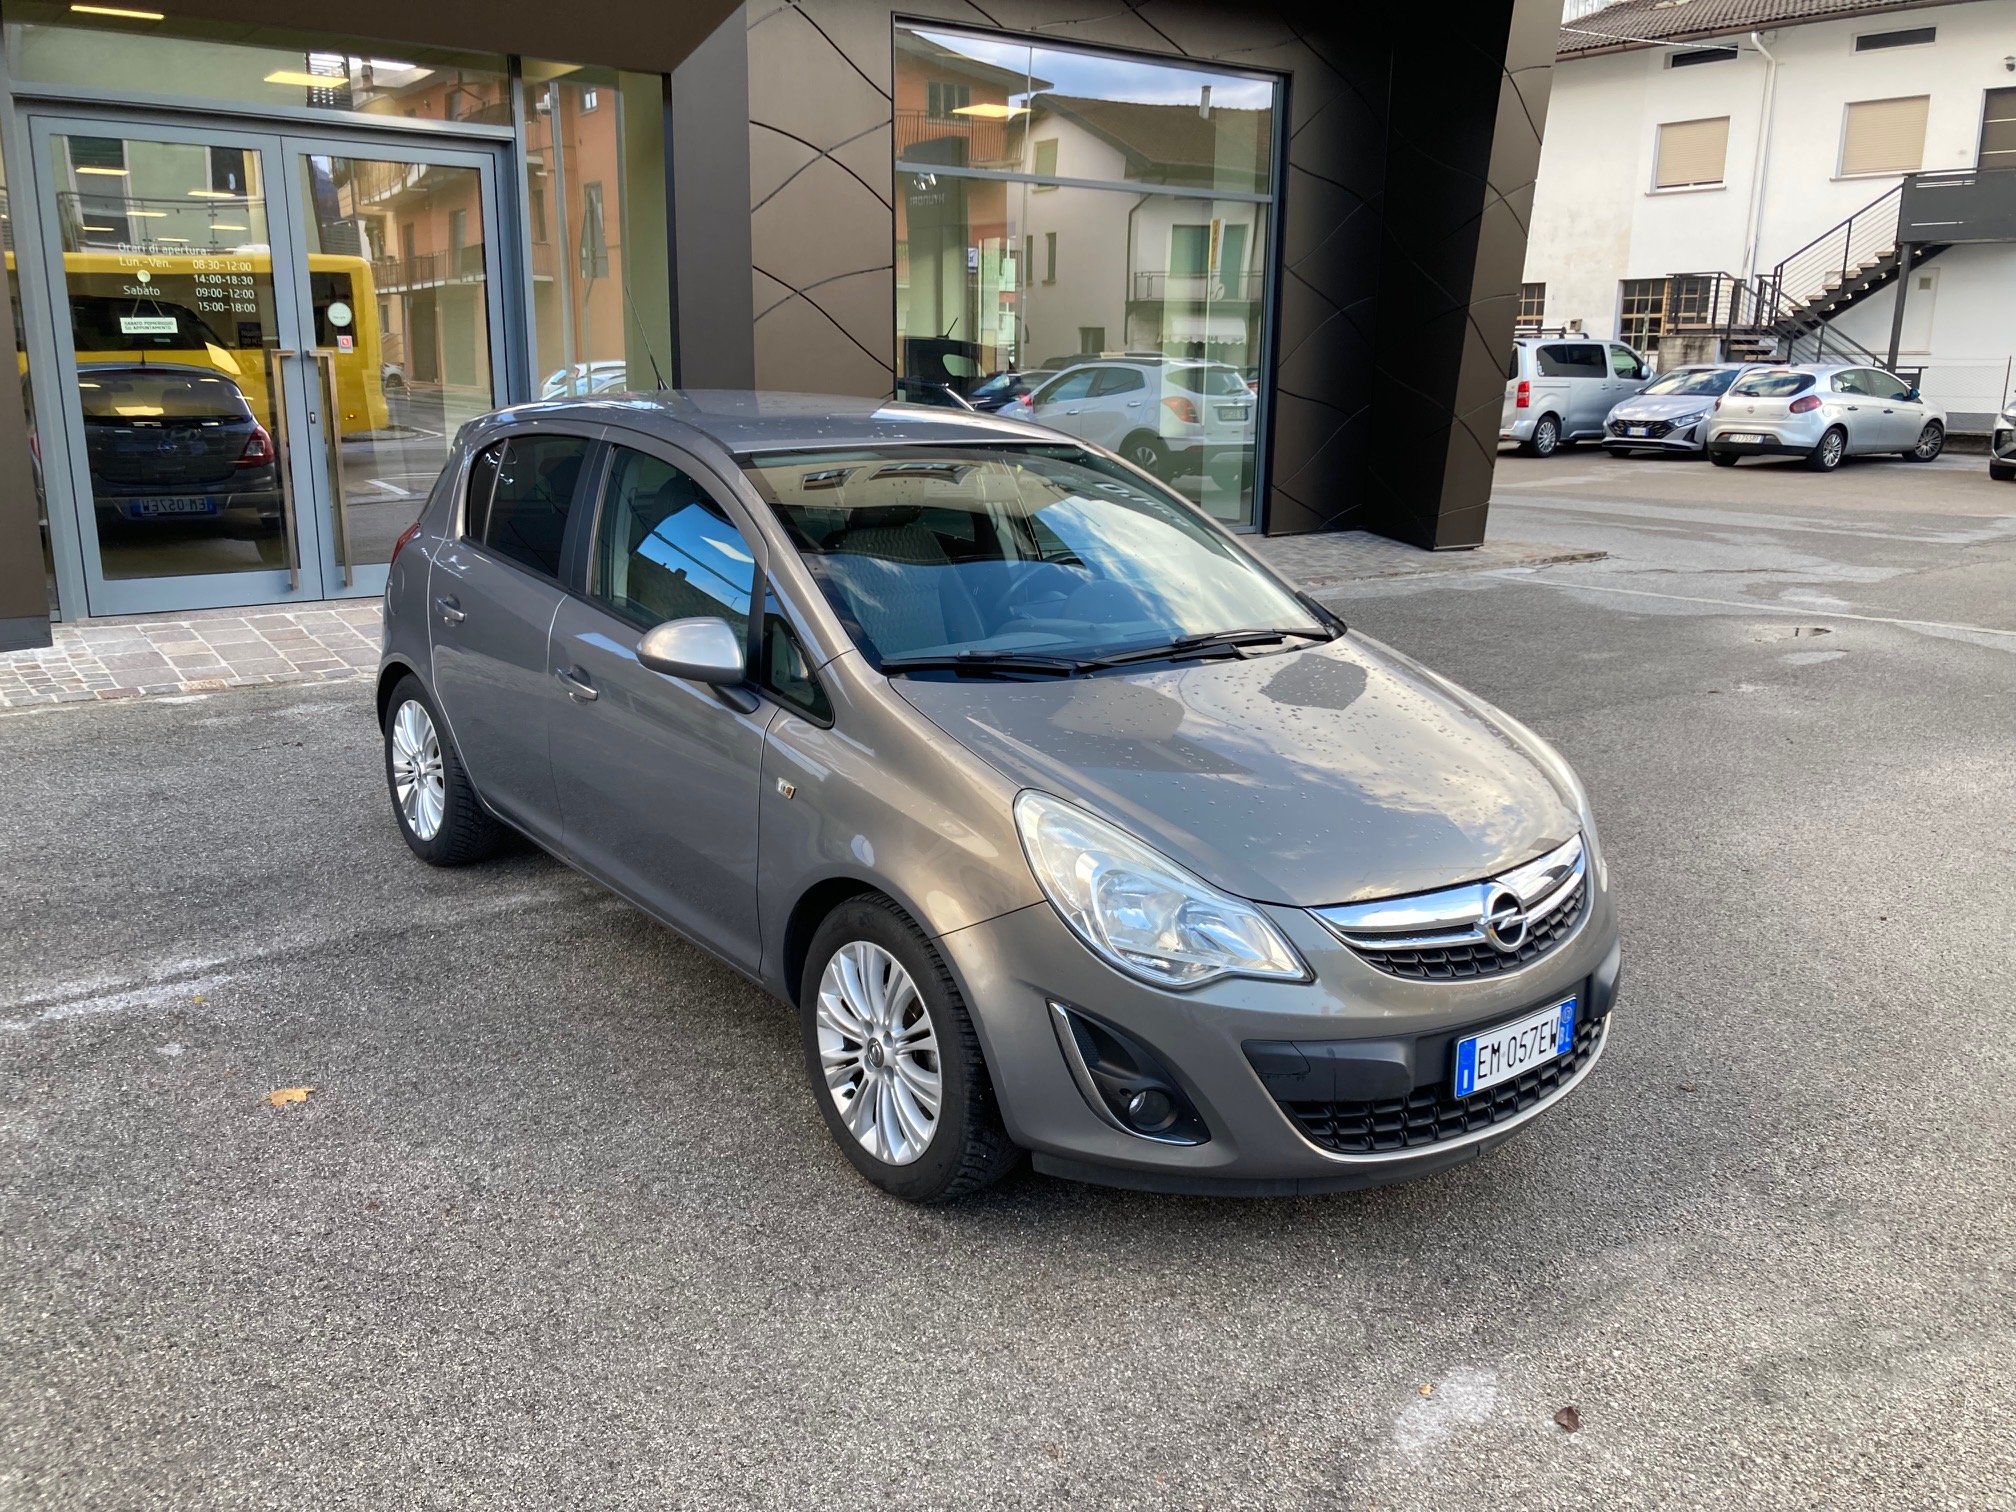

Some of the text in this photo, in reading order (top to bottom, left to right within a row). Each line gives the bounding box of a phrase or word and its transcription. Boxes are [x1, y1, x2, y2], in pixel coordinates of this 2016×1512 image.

[118, 242, 210, 256] Orari di apertura:
[119, 256, 252, 271] Lun.-Ven. 08:30-12:00
[193, 274, 254, 285] 14:00-18:30
[123, 285, 255, 299] Sabato 09:00-12:00
[198, 302, 256, 313] 15:00-18:00
[1477, 1040, 1502, 1080] EM
[1507, 1016, 1560, 1068] 057EW
